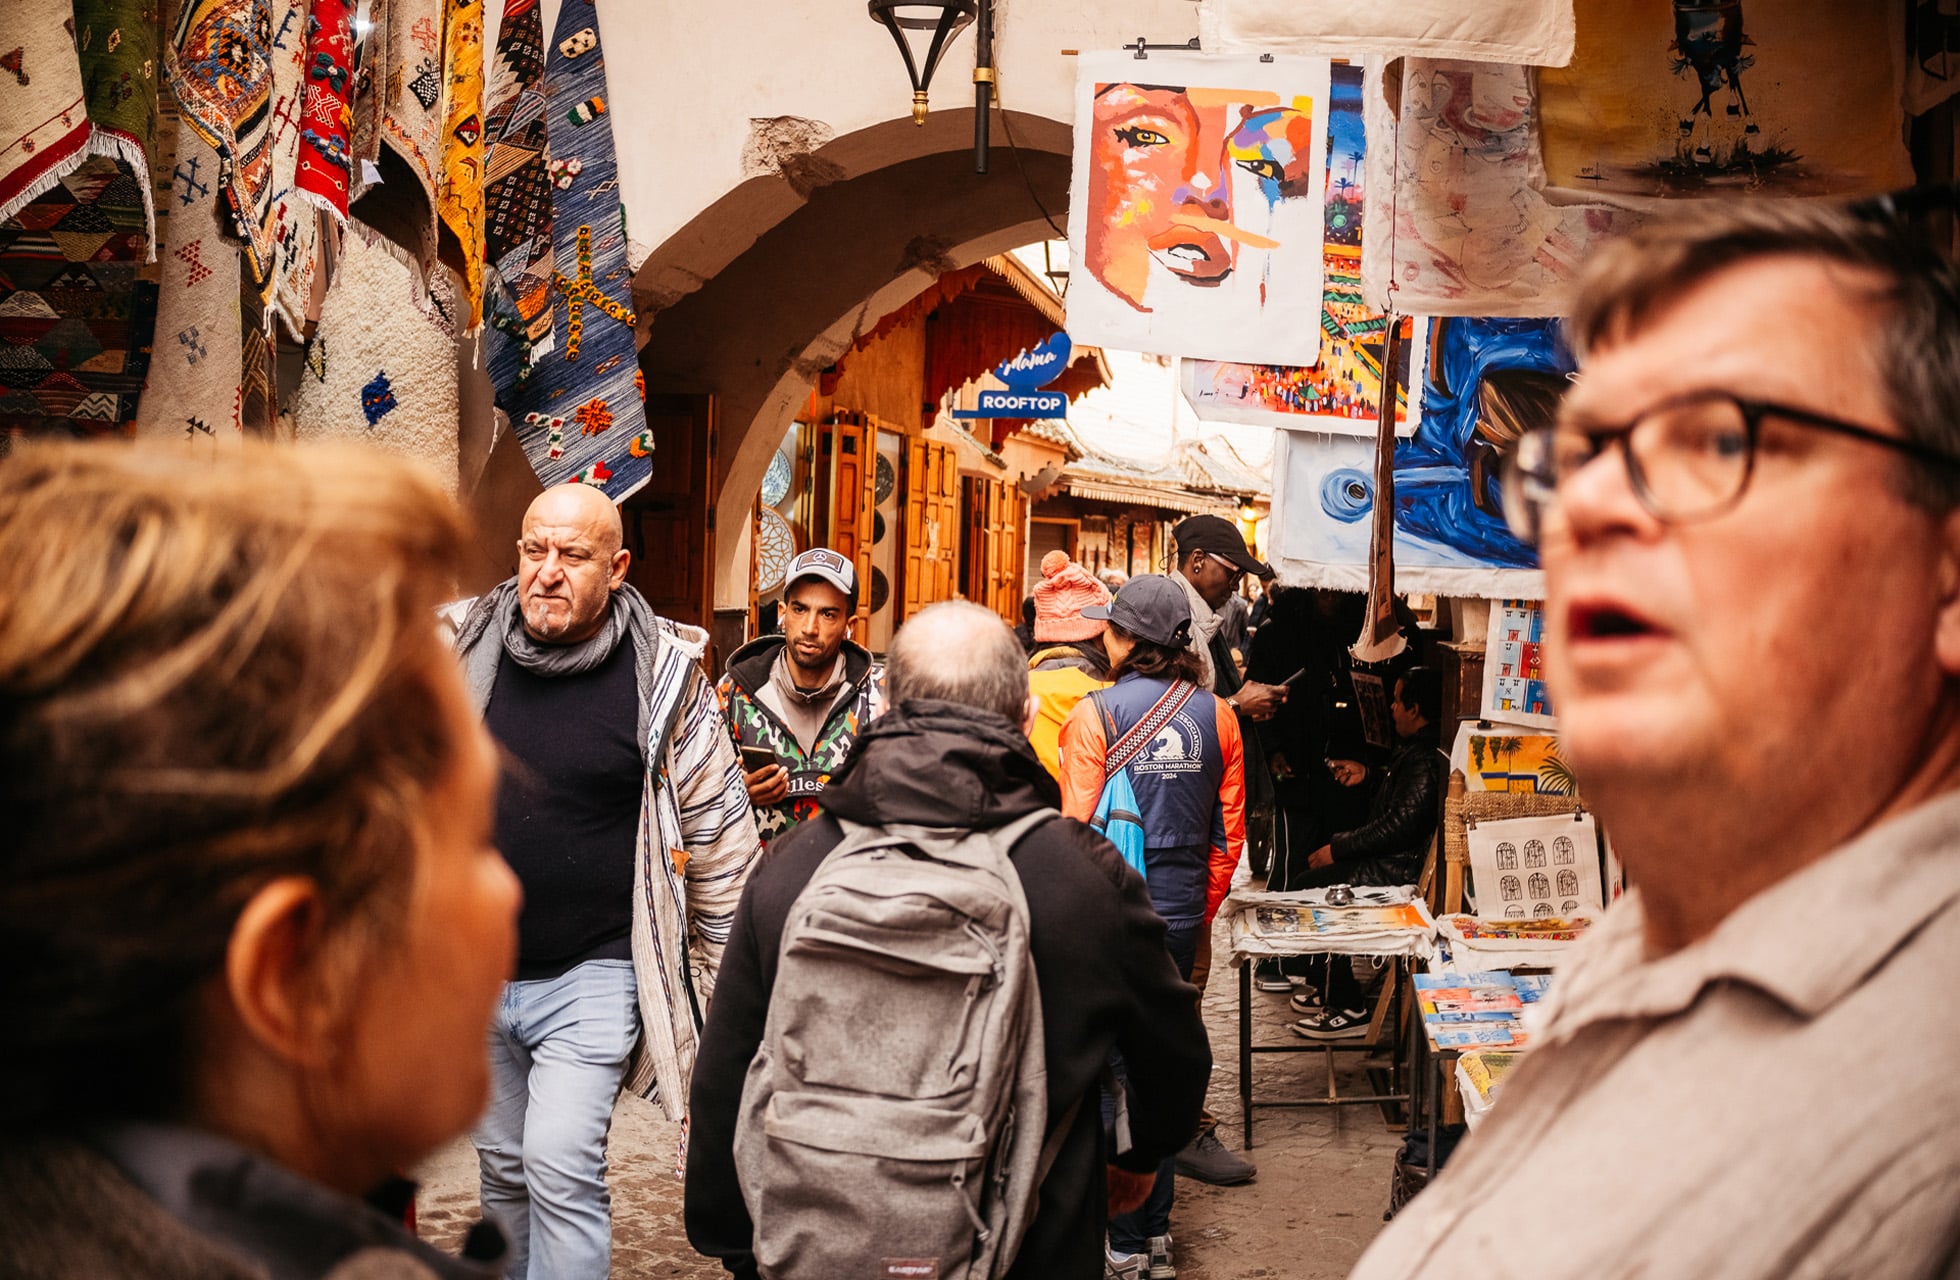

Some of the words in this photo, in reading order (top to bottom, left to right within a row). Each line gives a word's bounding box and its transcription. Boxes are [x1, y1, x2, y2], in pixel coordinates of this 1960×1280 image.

[983, 395, 1061, 410] ROOFTOP
[1133, 763, 1164, 771] BOSTON
[1165, 762, 1202, 770] MARATHON
